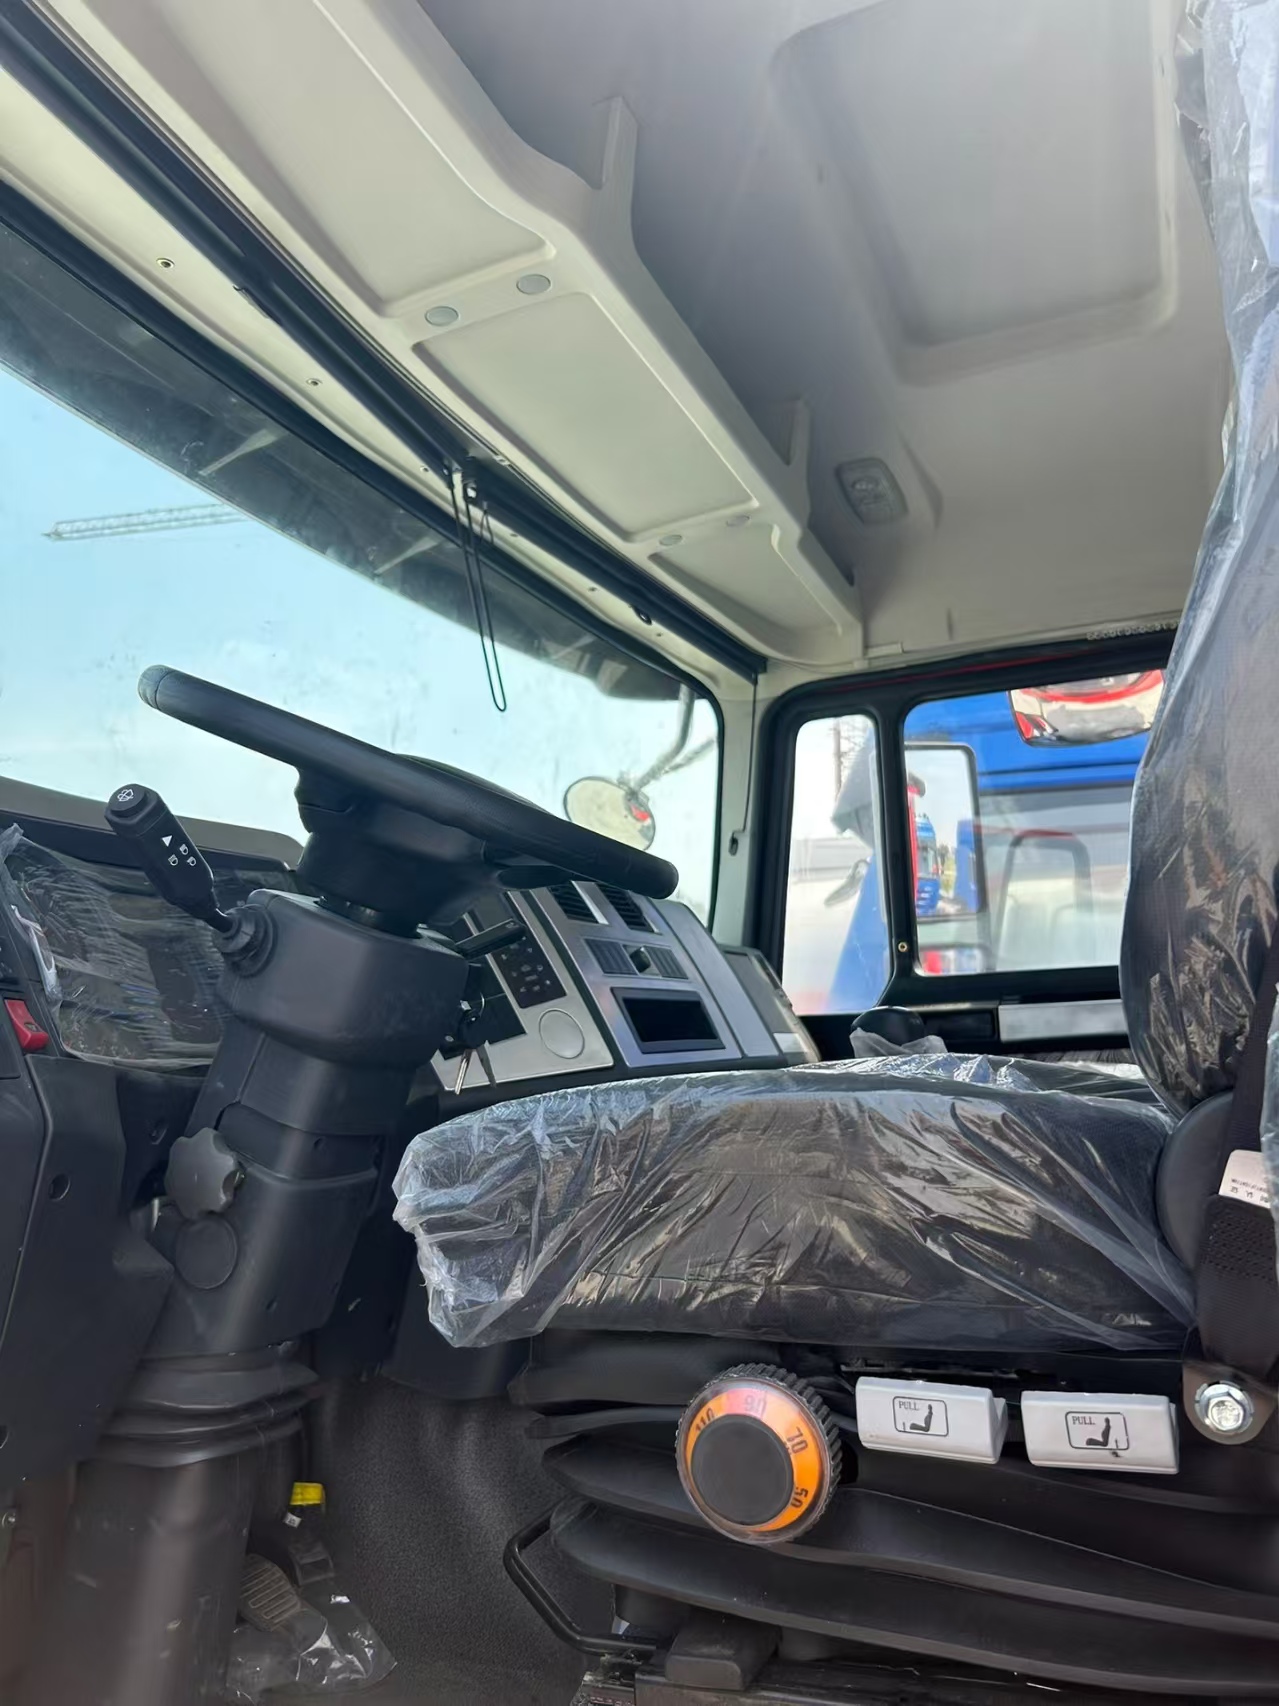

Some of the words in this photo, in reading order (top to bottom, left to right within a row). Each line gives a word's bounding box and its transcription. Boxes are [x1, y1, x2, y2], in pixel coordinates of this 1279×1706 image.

[744, 1394, 767, 1415] 90
[898, 1400, 920, 1411] PULL
[696, 1407, 715, 1432] 110
[1071, 1415, 1096, 1425] PULL
[787, 1426, 808, 1454] 70
[790, 1486, 809, 1508] 50
